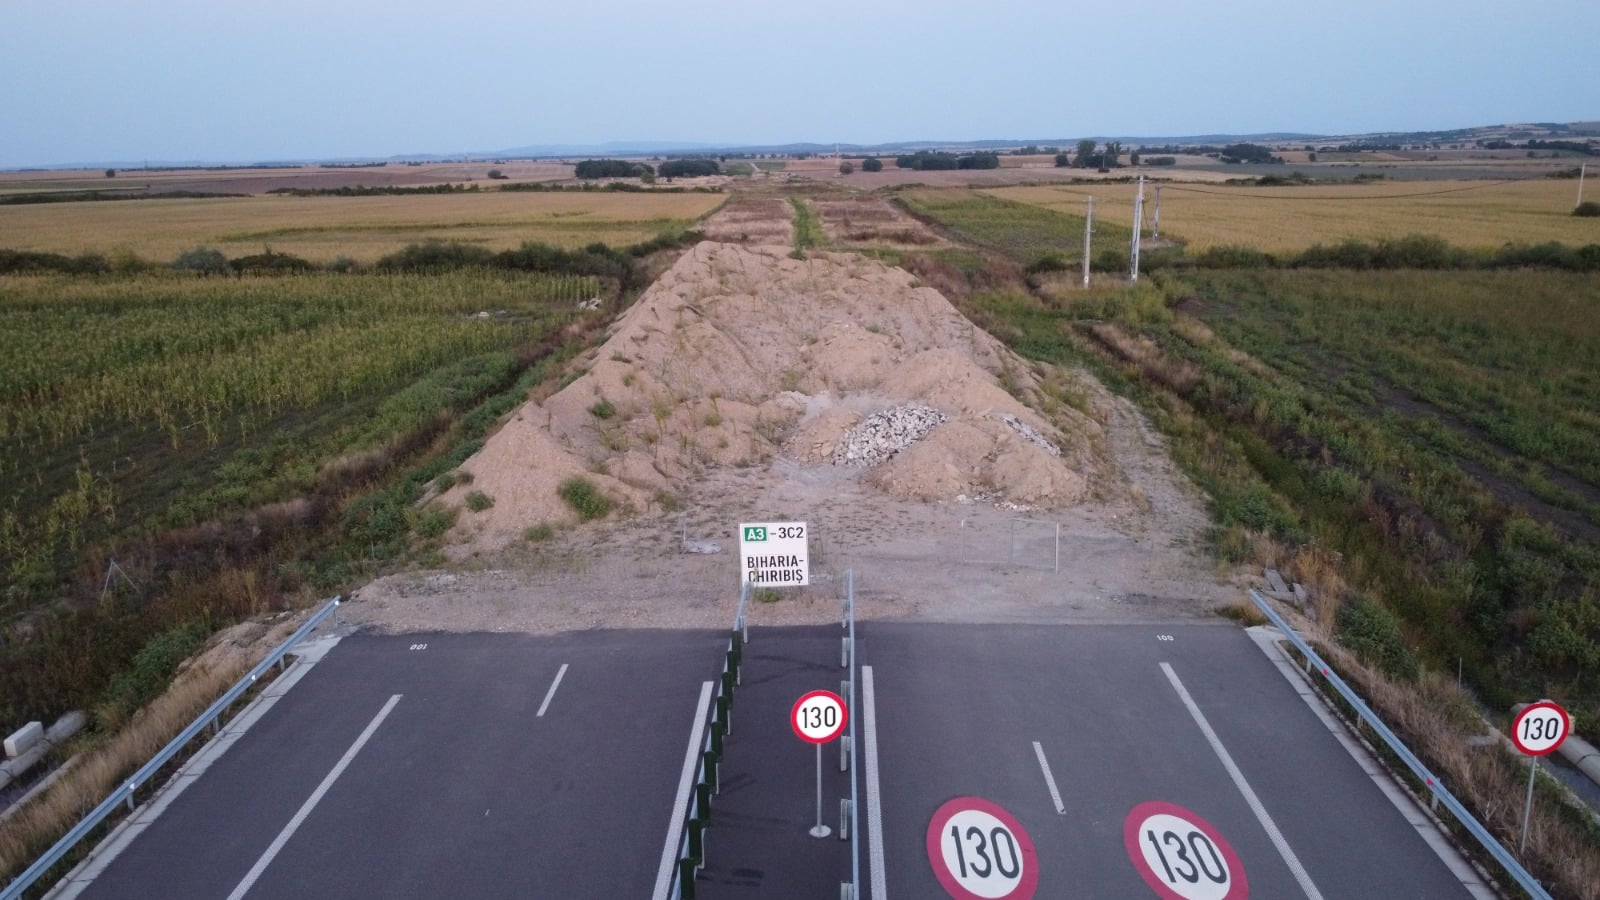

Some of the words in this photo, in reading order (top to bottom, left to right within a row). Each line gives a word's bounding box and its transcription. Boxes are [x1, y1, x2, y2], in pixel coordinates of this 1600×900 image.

[747, 528, 765, 541] A3
[747, 555, 804, 569] BIHARIA-
[802, 705, 836, 729] 130
[1523, 717, 1559, 740] 130
[951, 825, 1020, 879] 130
[1147, 830, 1228, 884] 130
